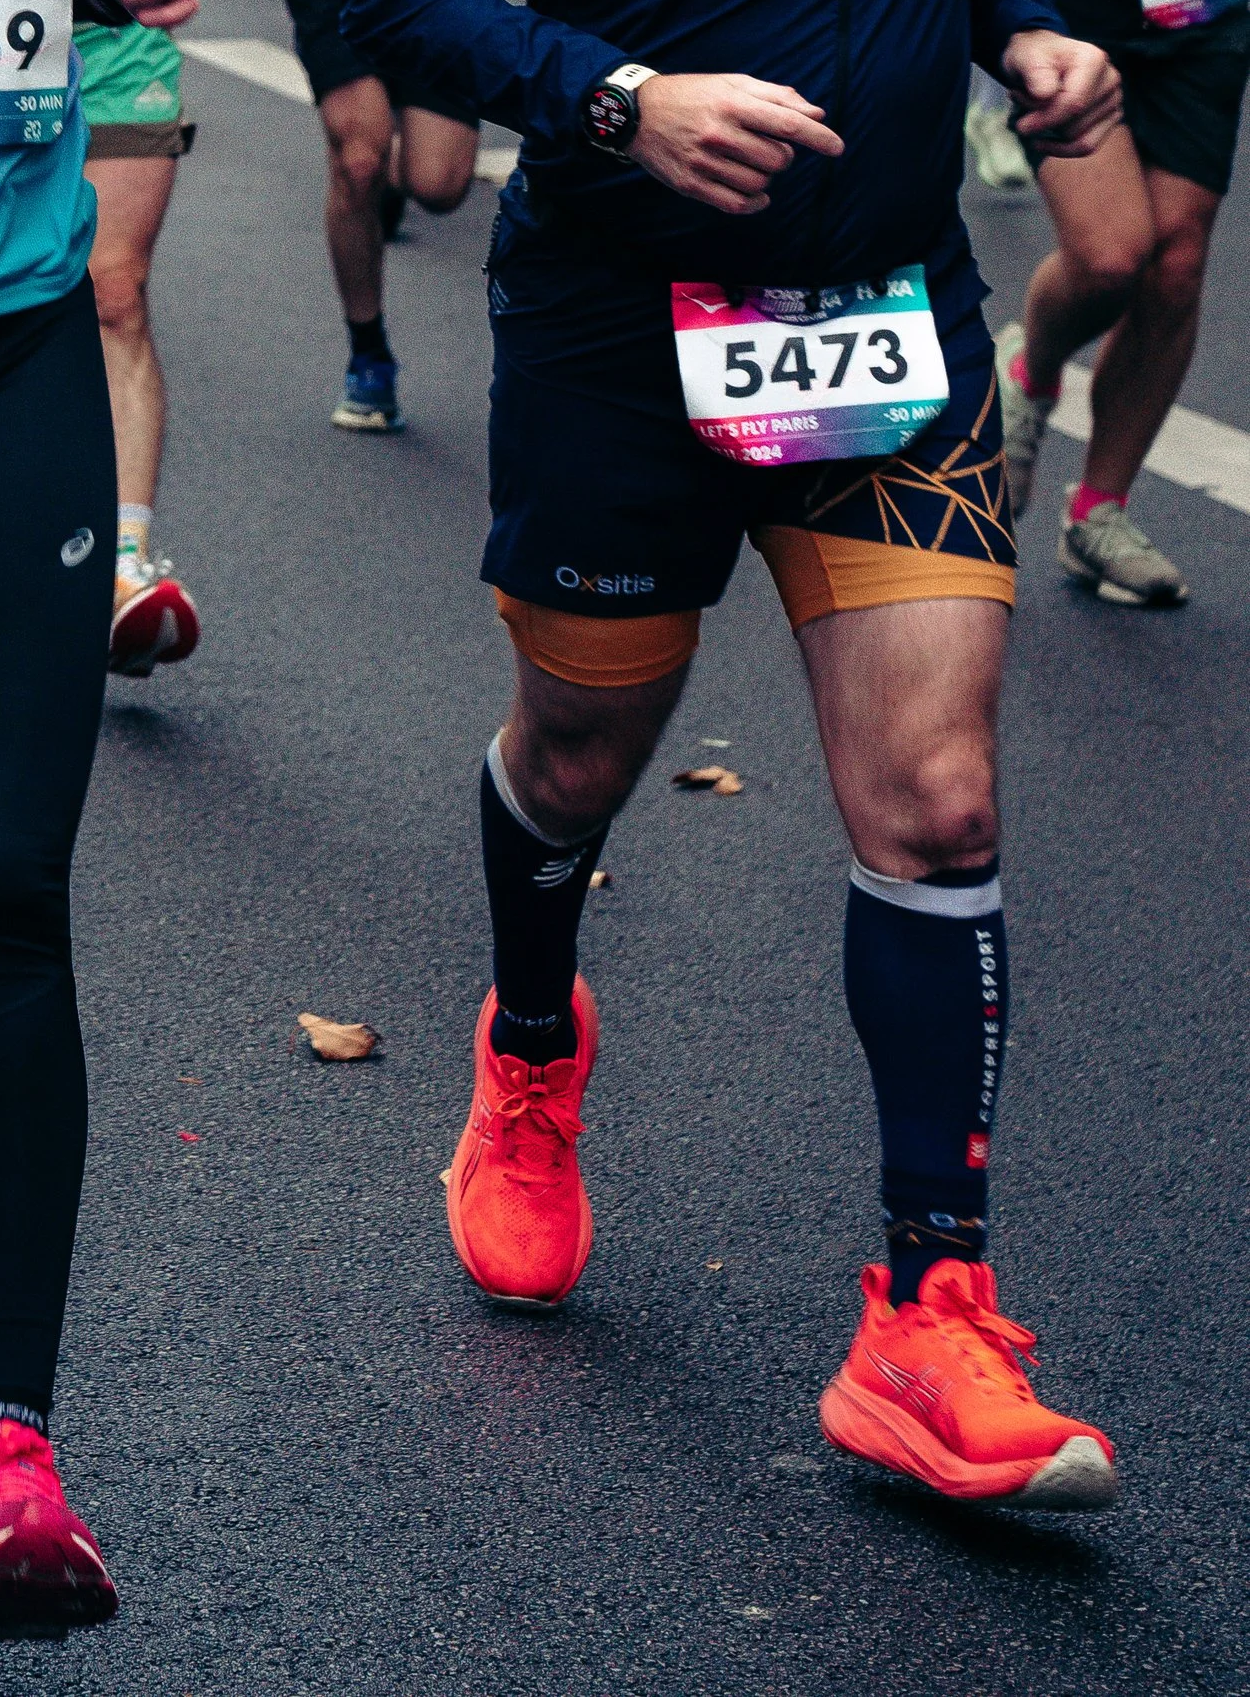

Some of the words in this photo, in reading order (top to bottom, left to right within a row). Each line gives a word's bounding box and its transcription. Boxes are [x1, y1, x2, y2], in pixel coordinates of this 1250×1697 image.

[14, 95, 37, 112] -50
[39, 94, 63, 111] MIN
[855, 279, 916, 300] HKA
[724, 328, 908, 399] 5473
[700, 422, 739, 438] LET'S
[741, 419, 769, 436] FLY
[770, 415, 820, 434] PARIS
[555, 566, 655, 594] Oxsitis
